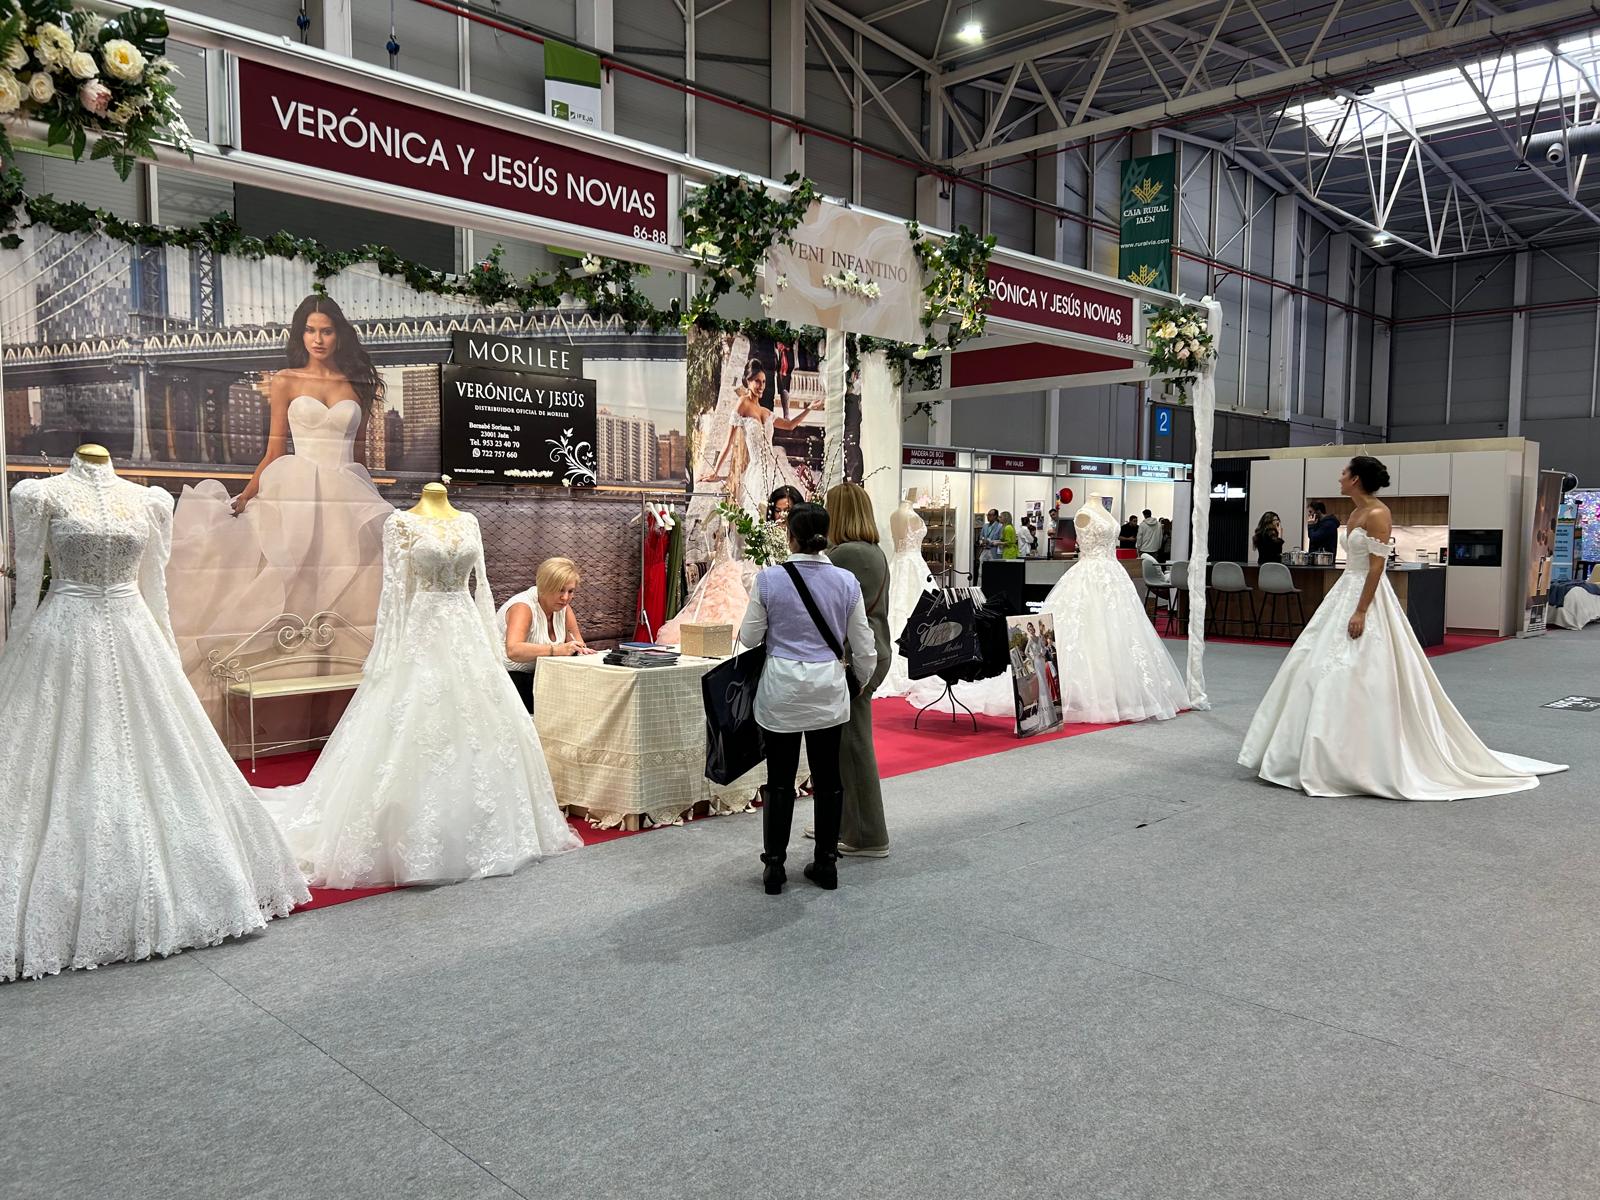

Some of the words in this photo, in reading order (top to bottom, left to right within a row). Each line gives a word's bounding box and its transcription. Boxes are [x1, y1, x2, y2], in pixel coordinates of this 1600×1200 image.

[271, 95, 450, 171] VERÓNICA
[456, 144, 475, 176] Y
[482, 153, 558, 196] JESÚS
[566, 173, 656, 219] NOVIAS
[1143, 204, 1169, 215] RURAL
[633, 225, 667, 244] 86-88
[1120, 238, 1170, 249] www.ruralvia.com
[788, 241, 825, 264] VENI
[831, 250, 908, 284] INFANTINO
[988, 276, 1038, 309] RÓNICA
[1040, 290, 1048, 310] Y
[1050, 292, 1080, 317] JESÚS
[1083, 301, 1121, 326] NOVIAS
[1116, 332, 1132, 344] 86-88
[469, 339, 570, 371] MORILEE
[455, 381, 533, 403] VERÓNICA
[535, 389, 546, 404] Y
[548, 390, 585, 409] JESÚS
[474, 404, 515, 414] DISTRIBUIDOR
[515, 408, 538, 416] OFICIAL
[468, 421, 491, 430] Bernabé
[491, 423, 513, 432] Soriano,
[1159, 411, 1168, 432] 2
[469, 438, 482, 446] Tel.
[482, 439, 494, 447] 953
[503, 440, 512, 448] 40
[481, 450, 493, 458] 722
[494, 450, 506, 458] 757
[506, 451, 518, 459] 660
[911, 449, 929, 457] MADERA
